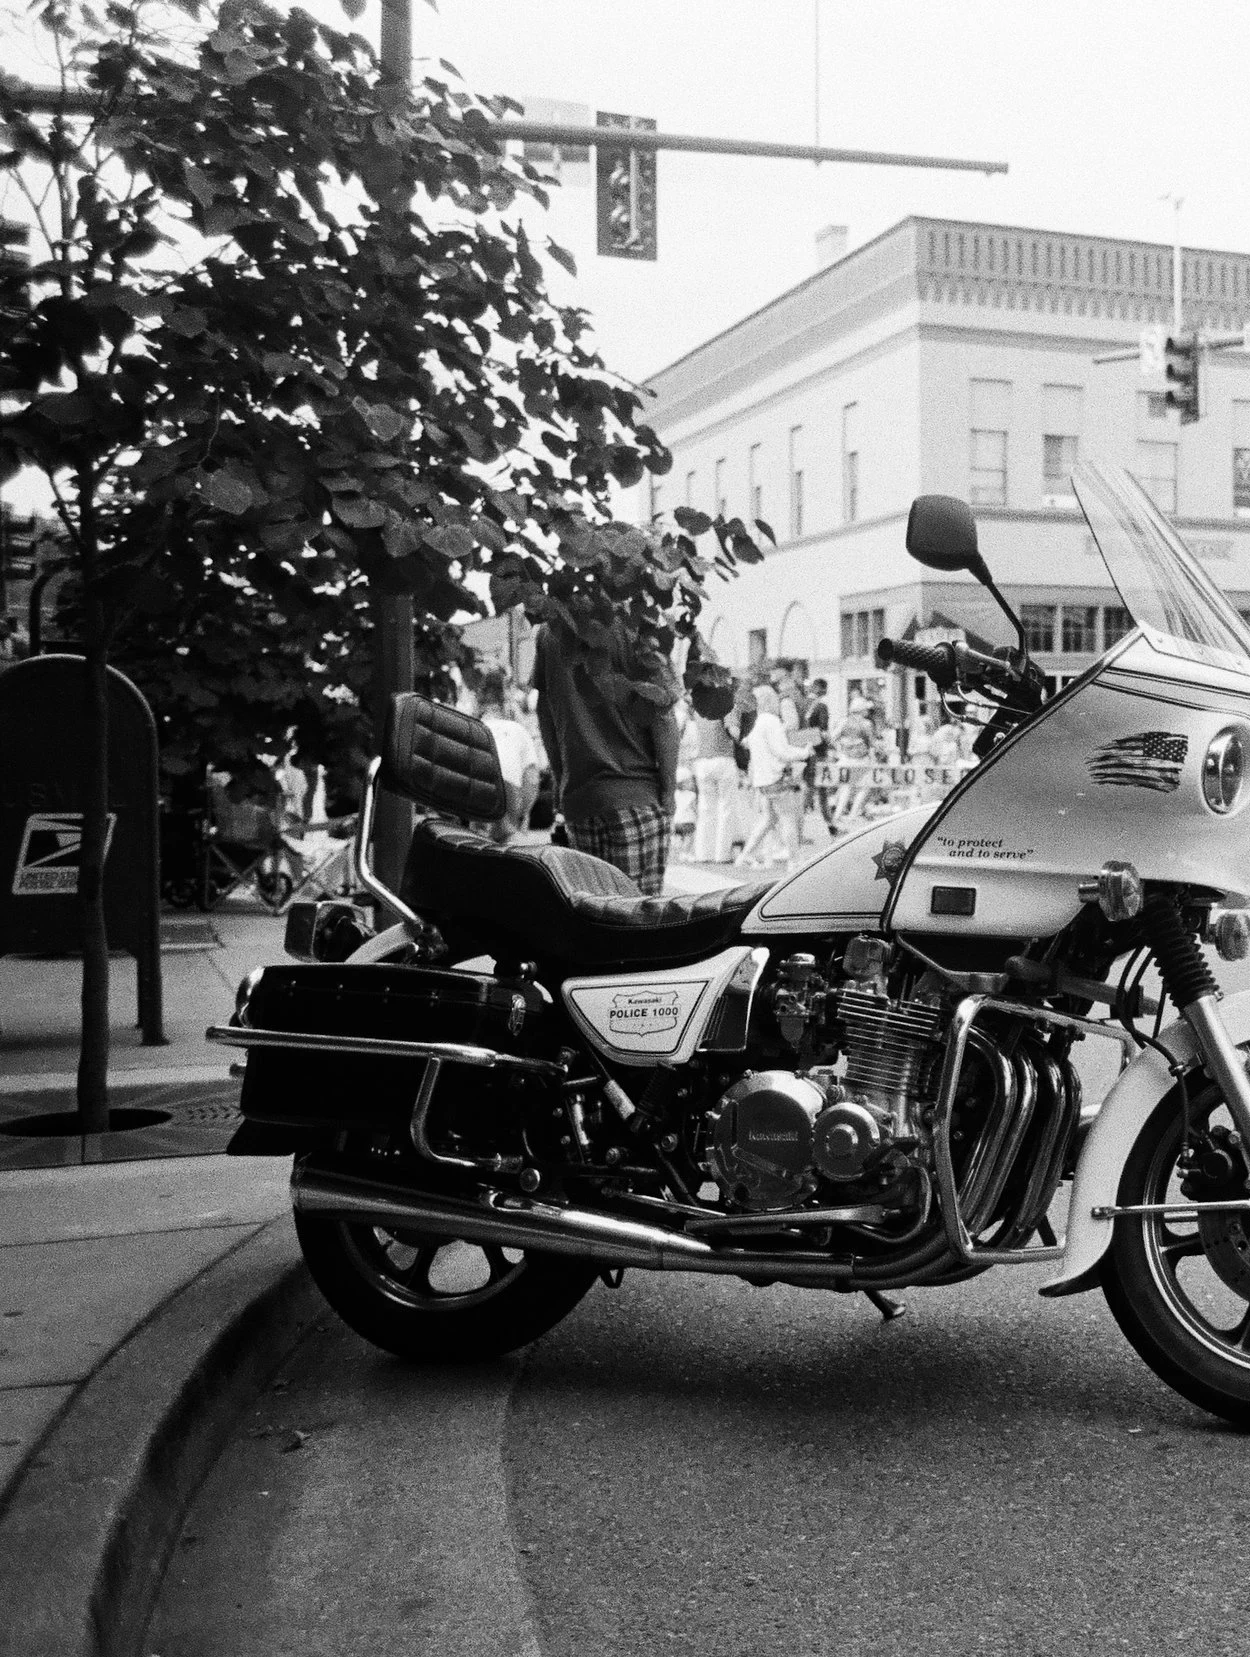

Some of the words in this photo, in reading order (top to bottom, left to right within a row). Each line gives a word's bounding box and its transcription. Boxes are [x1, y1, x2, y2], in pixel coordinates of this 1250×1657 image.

[957, 838, 1003, 850] protect
[949, 849, 975, 858] and
[977, 849, 990, 858] to
[610, 1008, 649, 1019] POLICE
[652, 1007, 679, 1017] 1000
